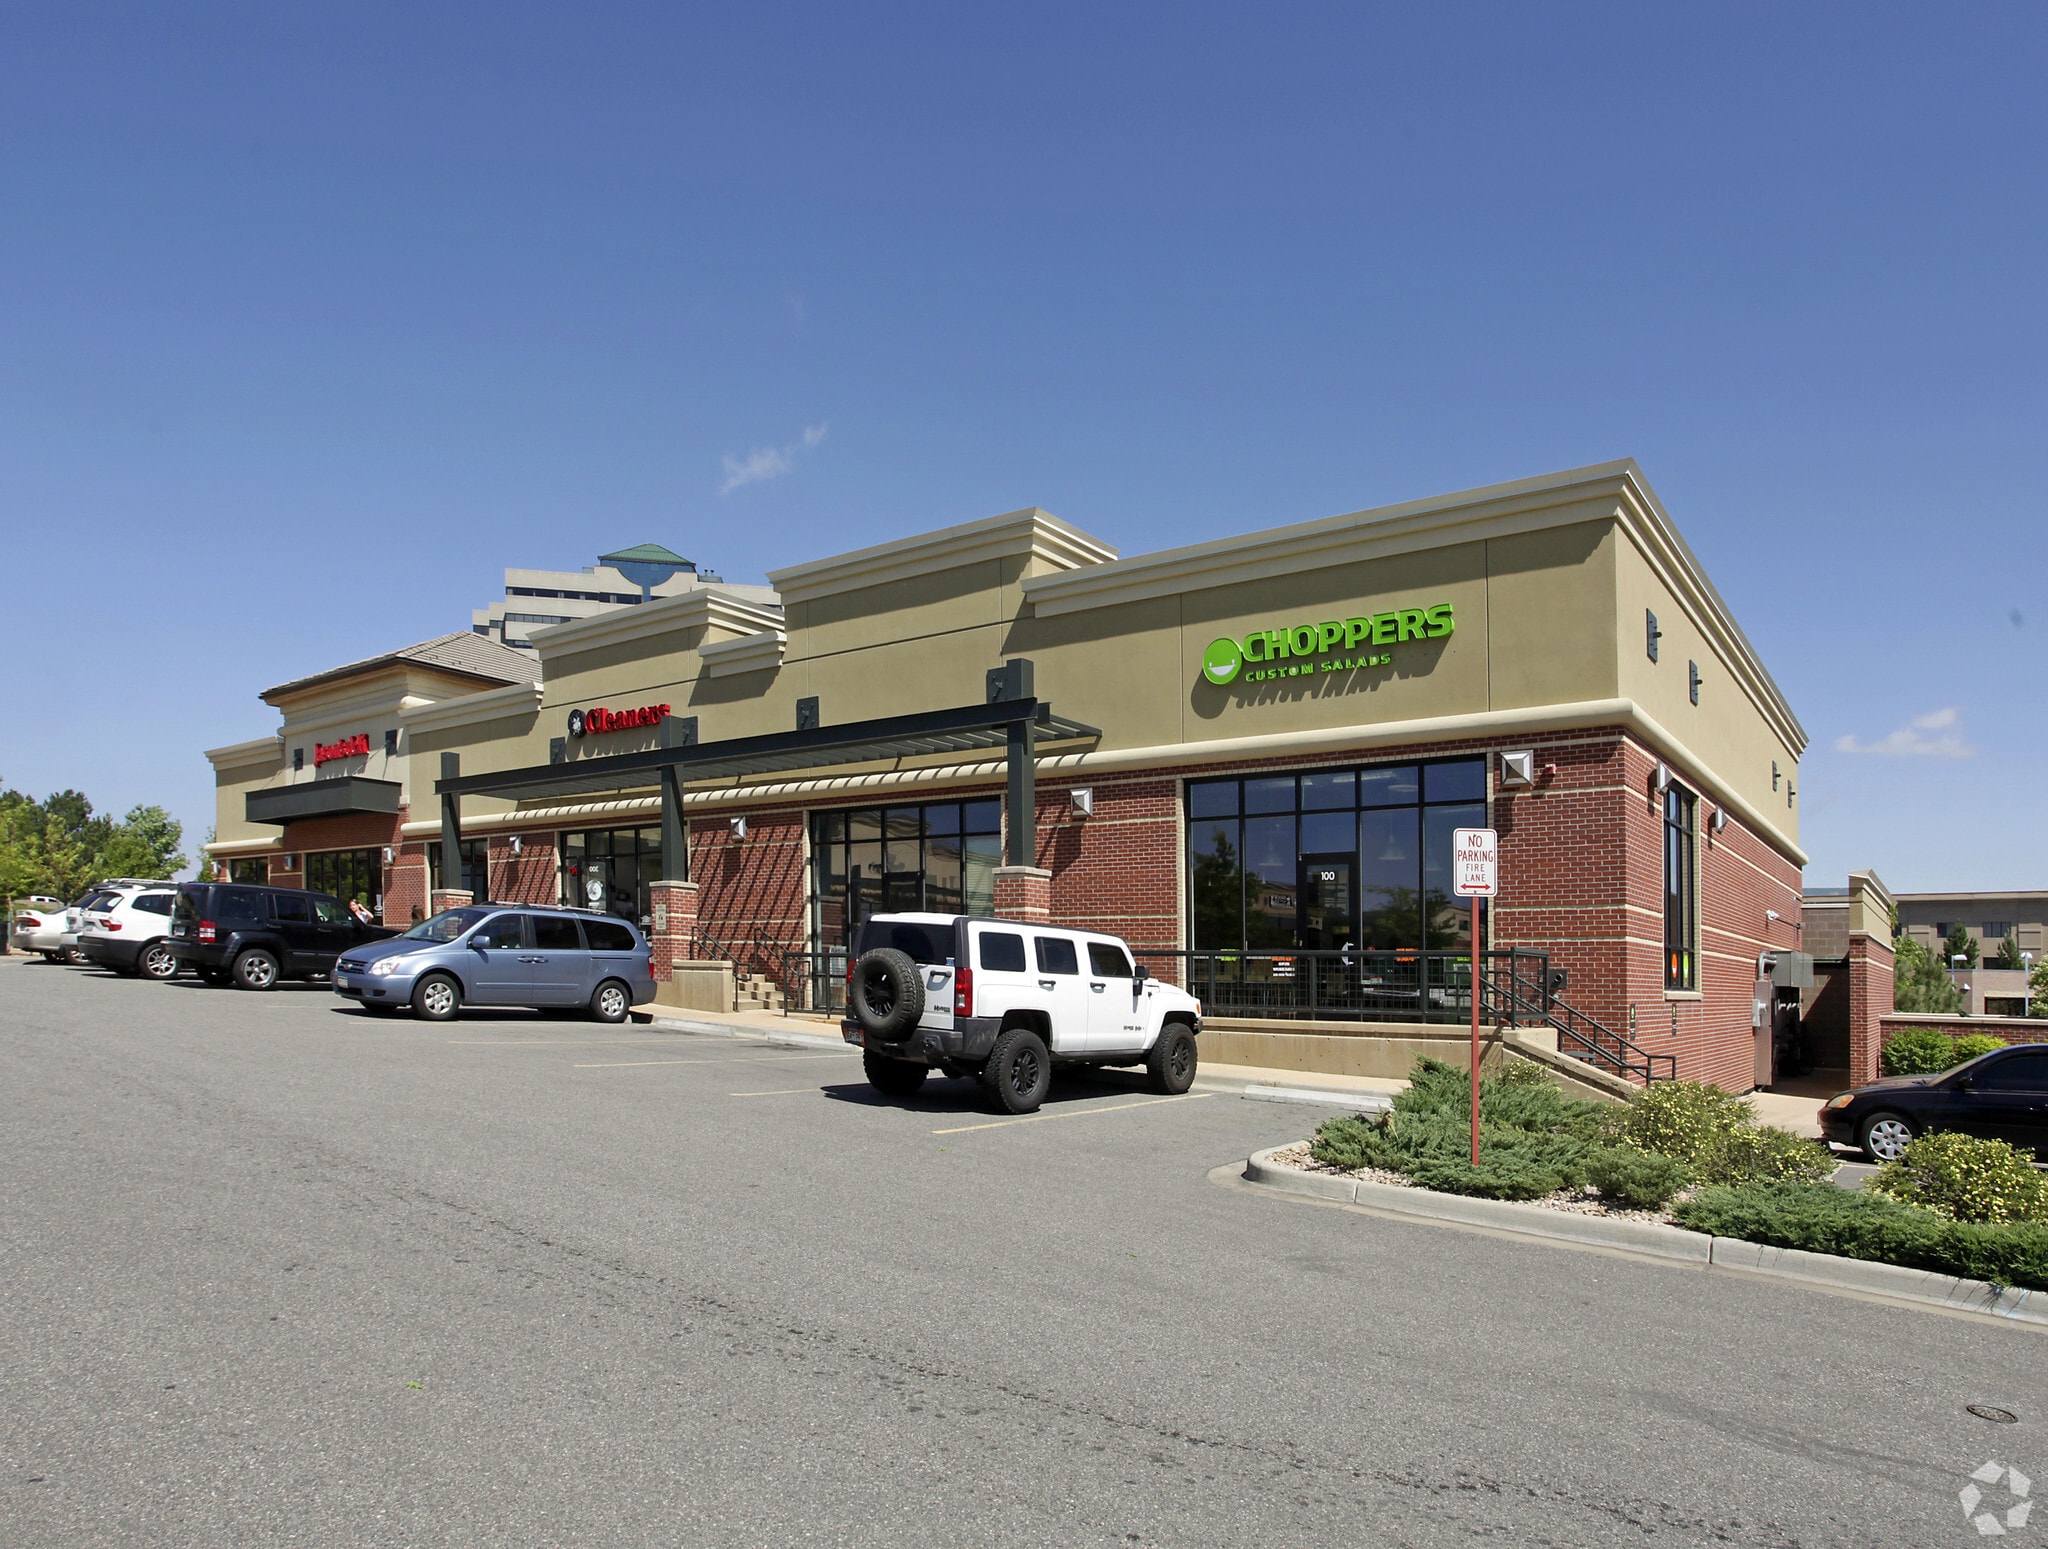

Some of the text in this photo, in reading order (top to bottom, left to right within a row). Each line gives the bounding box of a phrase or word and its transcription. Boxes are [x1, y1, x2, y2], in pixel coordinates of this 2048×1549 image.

[1243, 603, 1455, 662] CHOPPERS
[1245, 652, 1392, 682] CUSTOM SALADS
[584, 703, 670, 734] Cleaners
[1468, 835, 1482, 847] NO
[1458, 850, 1493, 862] PARKING
[1466, 863, 1485, 872] FIRE
[1320, 871, 1335, 881] 100
[1465, 873, 1486, 882] LANE
